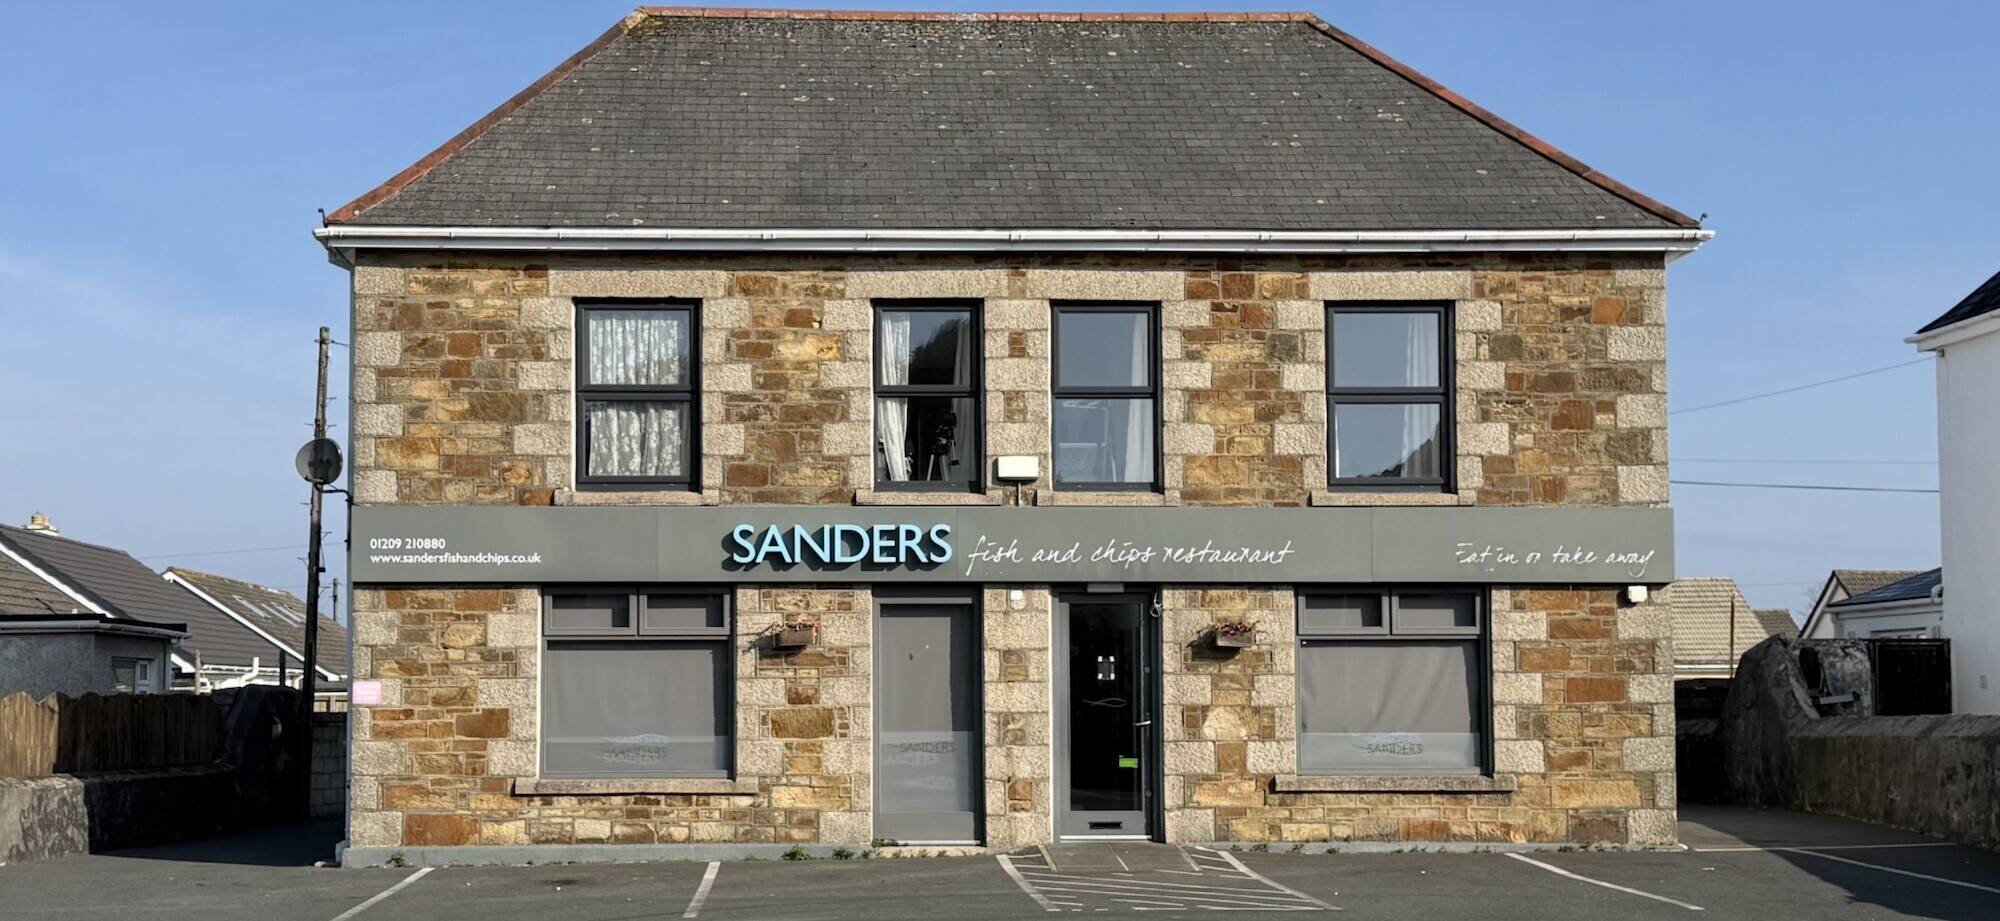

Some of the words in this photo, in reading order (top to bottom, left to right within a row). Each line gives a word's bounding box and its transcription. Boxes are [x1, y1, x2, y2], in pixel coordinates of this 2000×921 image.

[370, 538, 402, 549] 01209
[405, 538, 446, 549] 210880
[732, 524, 952, 563] SANDERS
[370, 553, 541, 566] www.sandersfishandchips.co.uk
[965, 536, 1024, 576] fish
[1031, 542, 1082, 563] and
[1090, 539, 1156, 569] chips
[1162, 539, 1295, 564] restaurant
[1456, 542, 1492, 564] Eat
[1496, 547, 1519, 564] in
[1526, 551, 1543, 564] or
[1552, 545, 1598, 564] take
[1605, 550, 1655, 578] away
[900, 741, 957, 753] SANDERS
